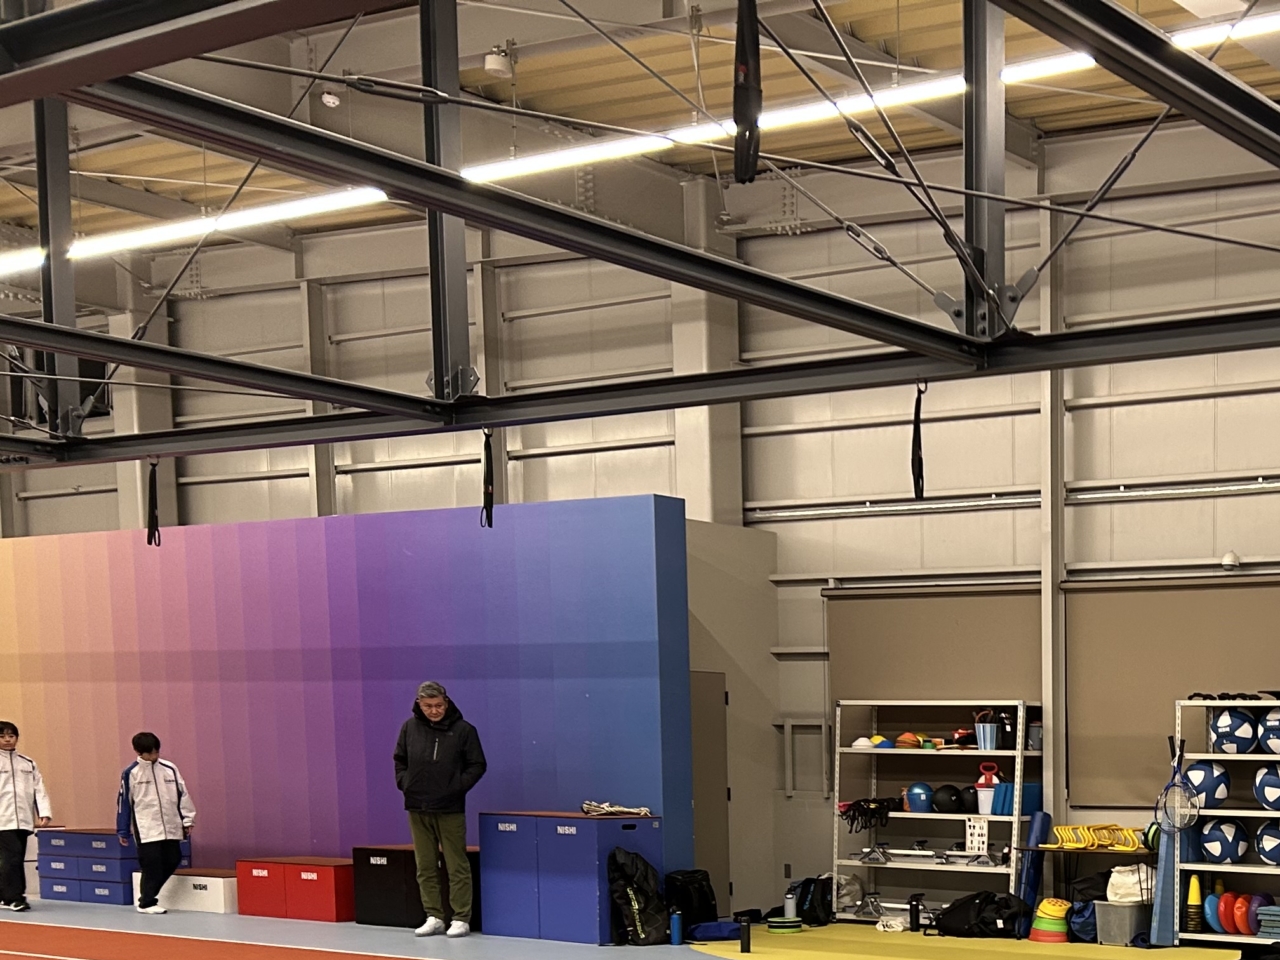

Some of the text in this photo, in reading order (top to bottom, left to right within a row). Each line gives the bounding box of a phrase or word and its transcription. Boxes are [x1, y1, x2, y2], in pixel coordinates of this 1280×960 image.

[498, 822, 517, 832] NISHI
[557, 825, 577, 835] NISHI
[370, 856, 387, 865] NISHI
[252, 868, 268, 877] NISHI
[301, 871, 318, 880] NISHI
[193, 883, 208, 891] NISHI
